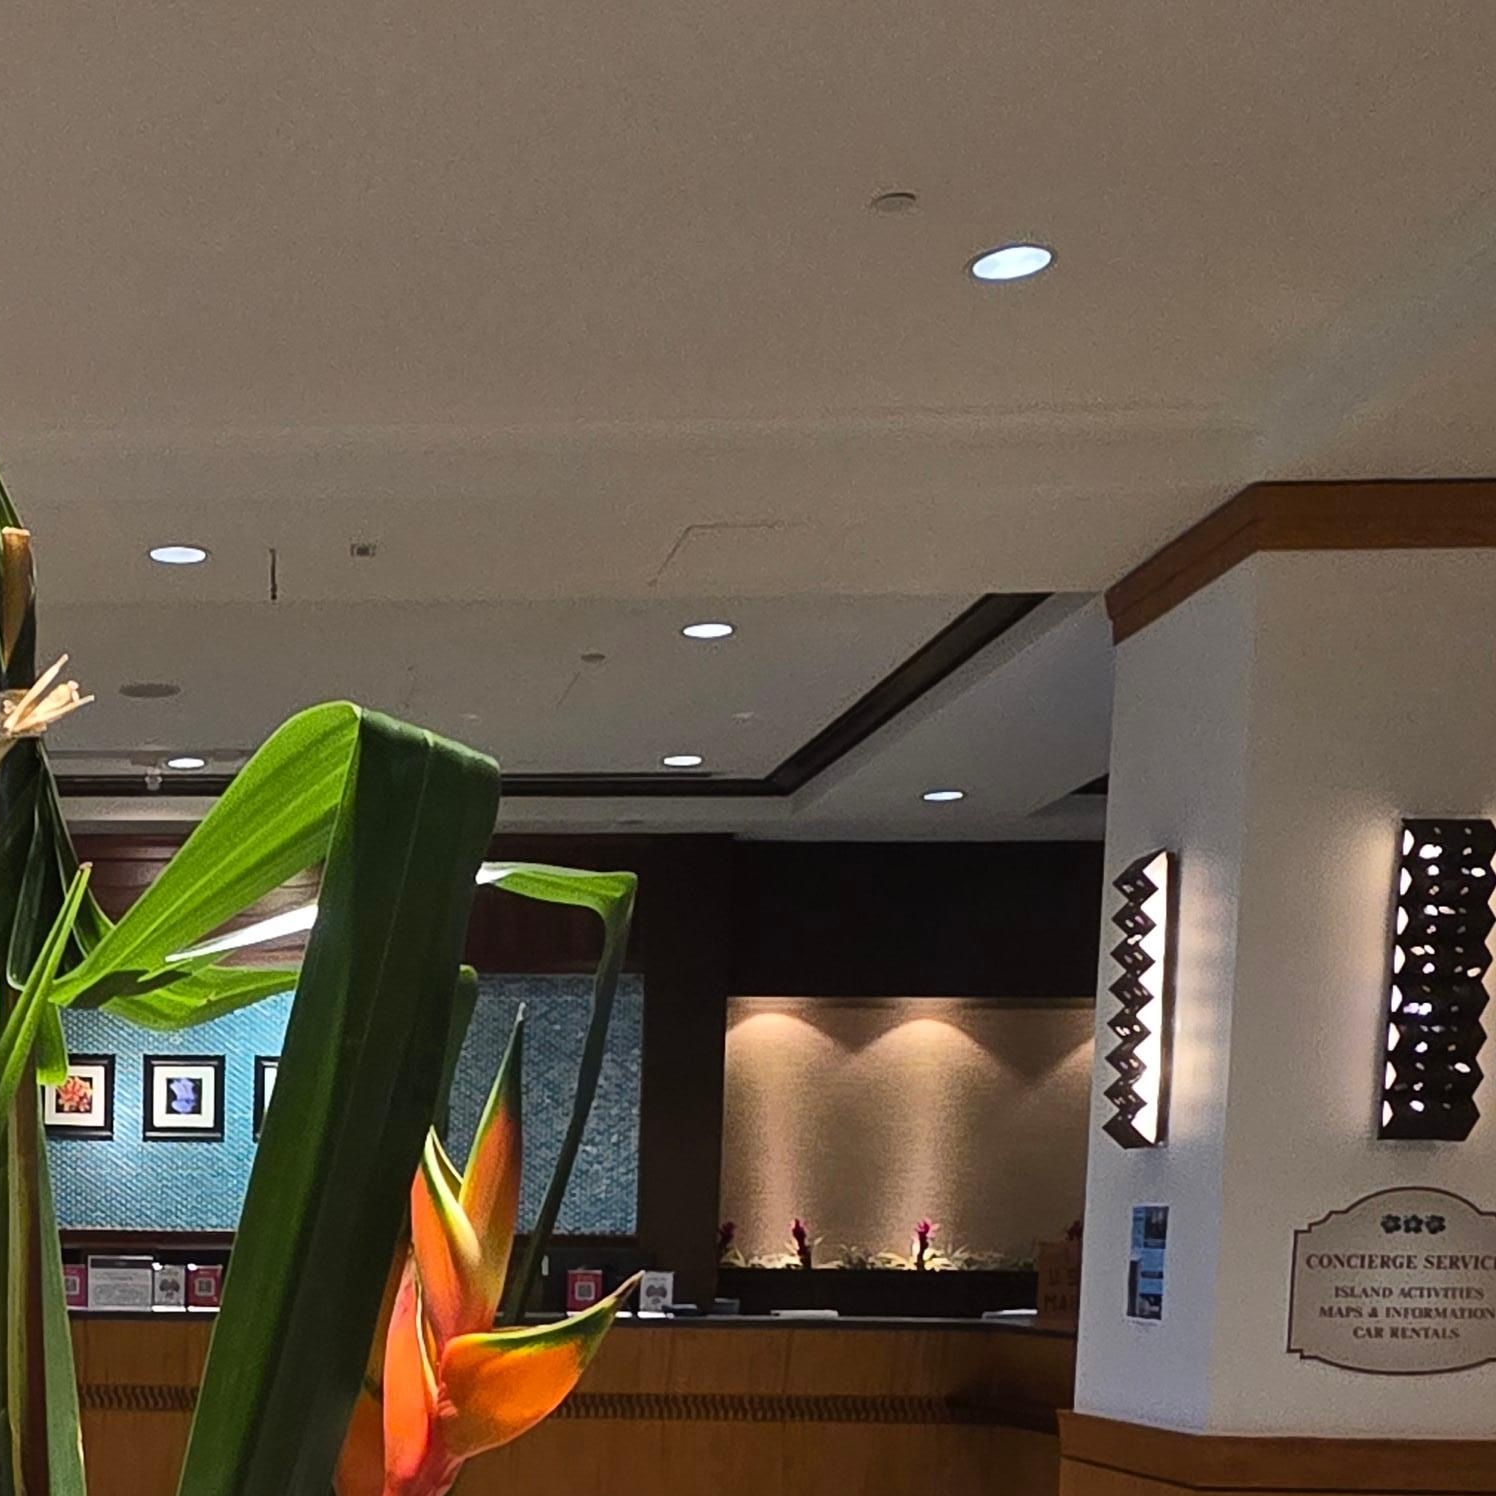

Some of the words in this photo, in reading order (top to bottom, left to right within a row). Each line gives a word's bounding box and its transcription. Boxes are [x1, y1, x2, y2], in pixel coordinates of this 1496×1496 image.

[1306, 1254, 1418, 1270] CONCIERGE
[1422, 1254, 1496, 1270] SERVIC
[1334, 1286, 1393, 1299] ISLAND
[1399, 1286, 1485, 1300] ACTIVITIES
[1319, 1306, 1363, 1319] MAPS
[1368, 1307, 1378, 1318] &
[1385, 1306, 1496, 1319] INFORMATION
[1353, 1326, 1384, 1340] CAR
[1389, 1326, 1461, 1341] RENTALS
